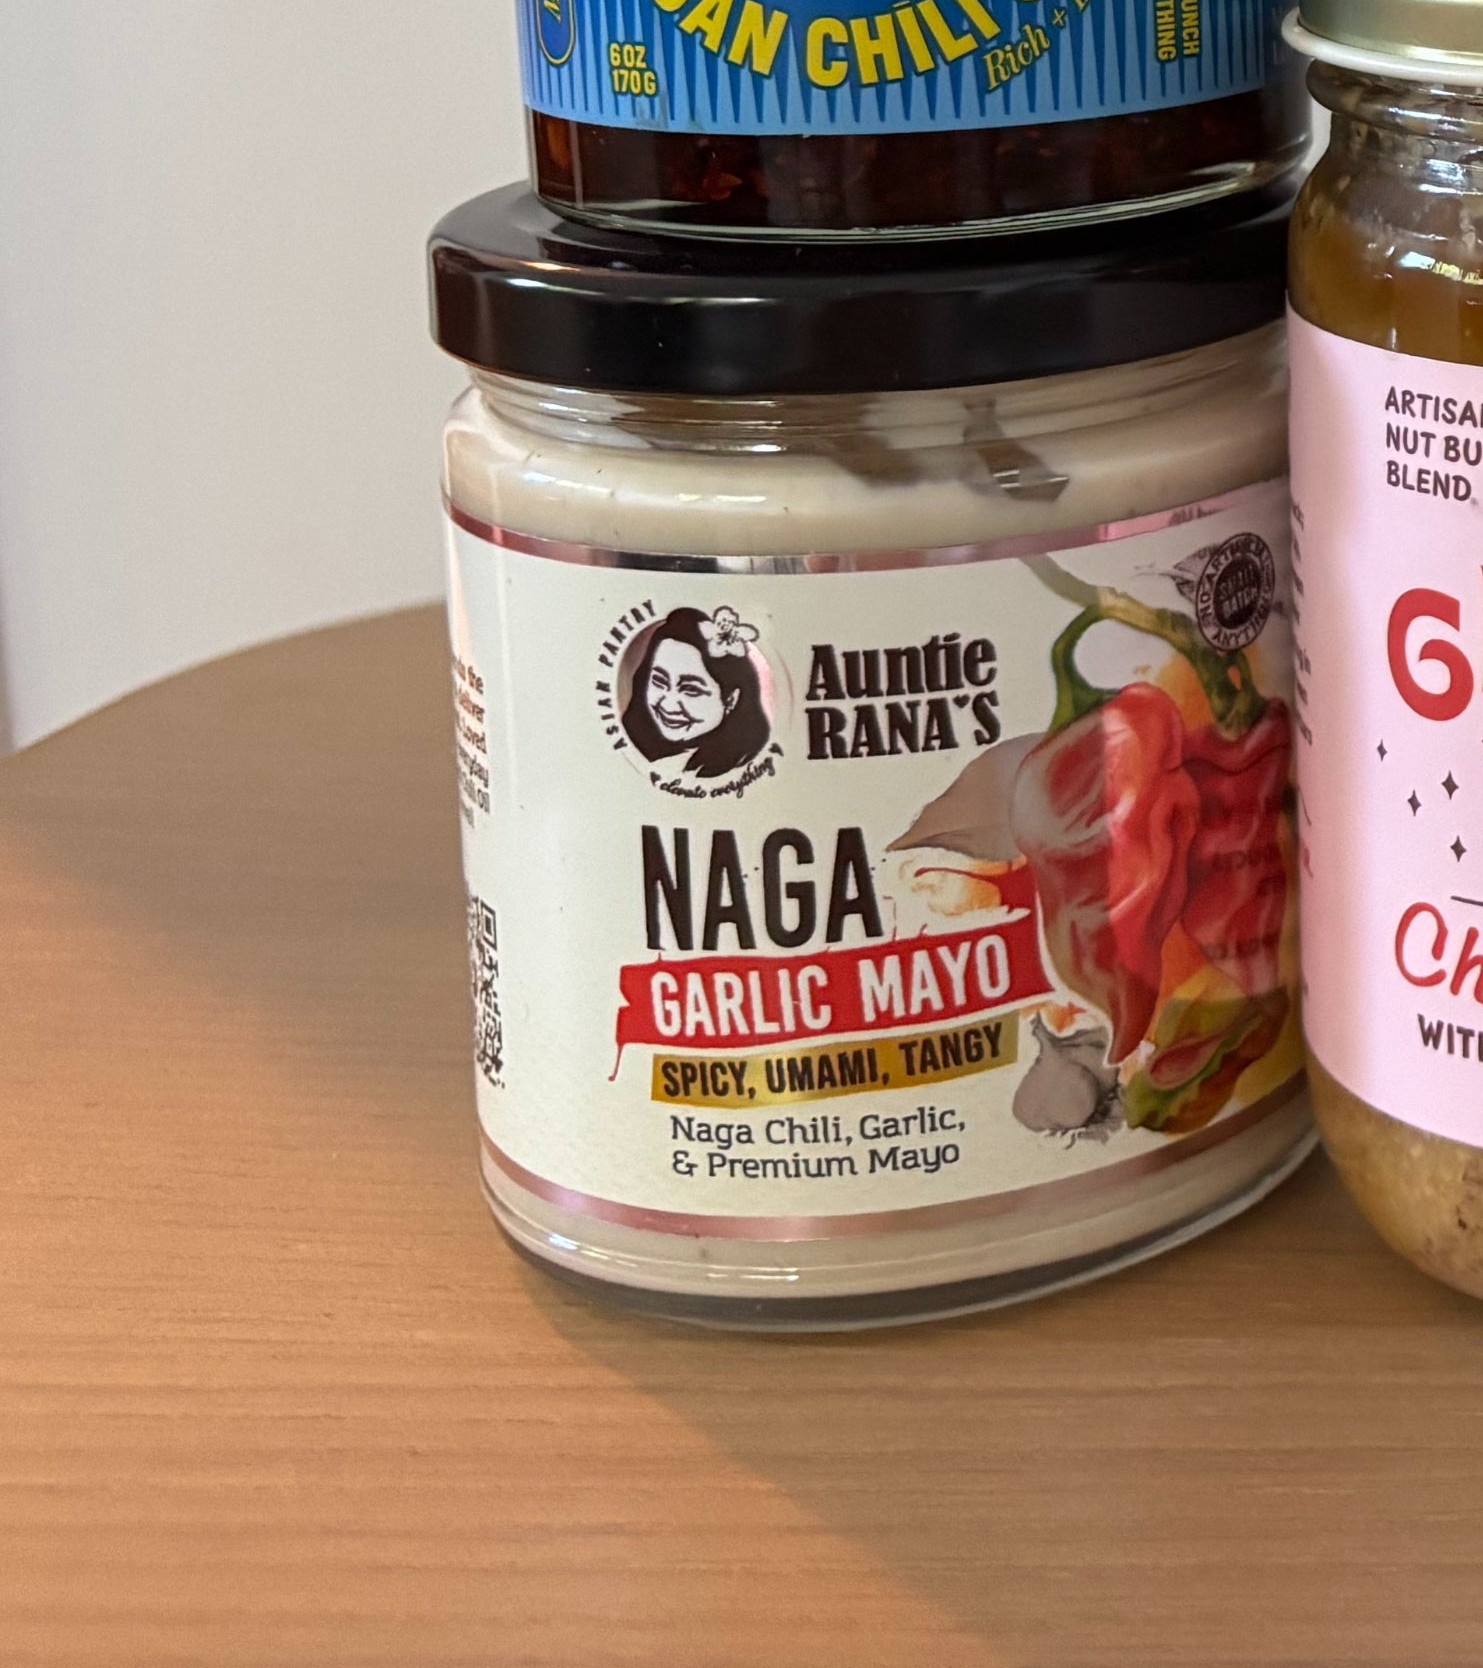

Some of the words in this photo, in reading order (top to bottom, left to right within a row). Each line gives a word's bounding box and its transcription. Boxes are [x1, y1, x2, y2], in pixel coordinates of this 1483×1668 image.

[1386, 422, 1436, 457] NUT
[1386, 461, 1473, 501] BLEND
[806, 632, 998, 701] Auntie
[806, 690, 1001, 760] RANA'S
[641, 826, 884, 951] NAGA
[650, 964, 831, 1038] GARLIC
[857, 934, 1011, 1023] MAYO
[661, 1060, 756, 1101] SPICY,
[765, 1047, 890, 1095] UMAMI,
[899, 1022, 1003, 1076] TANGY
[670, 1115, 754, 1150] Naga
[765, 1114, 853, 1146] Chili,
[859, 1105, 966, 1138] Garlic,
[672, 1150, 698, 1177] &
[708, 1150, 857, 1179] Premium
[868, 1142, 961, 1175] Mayo
